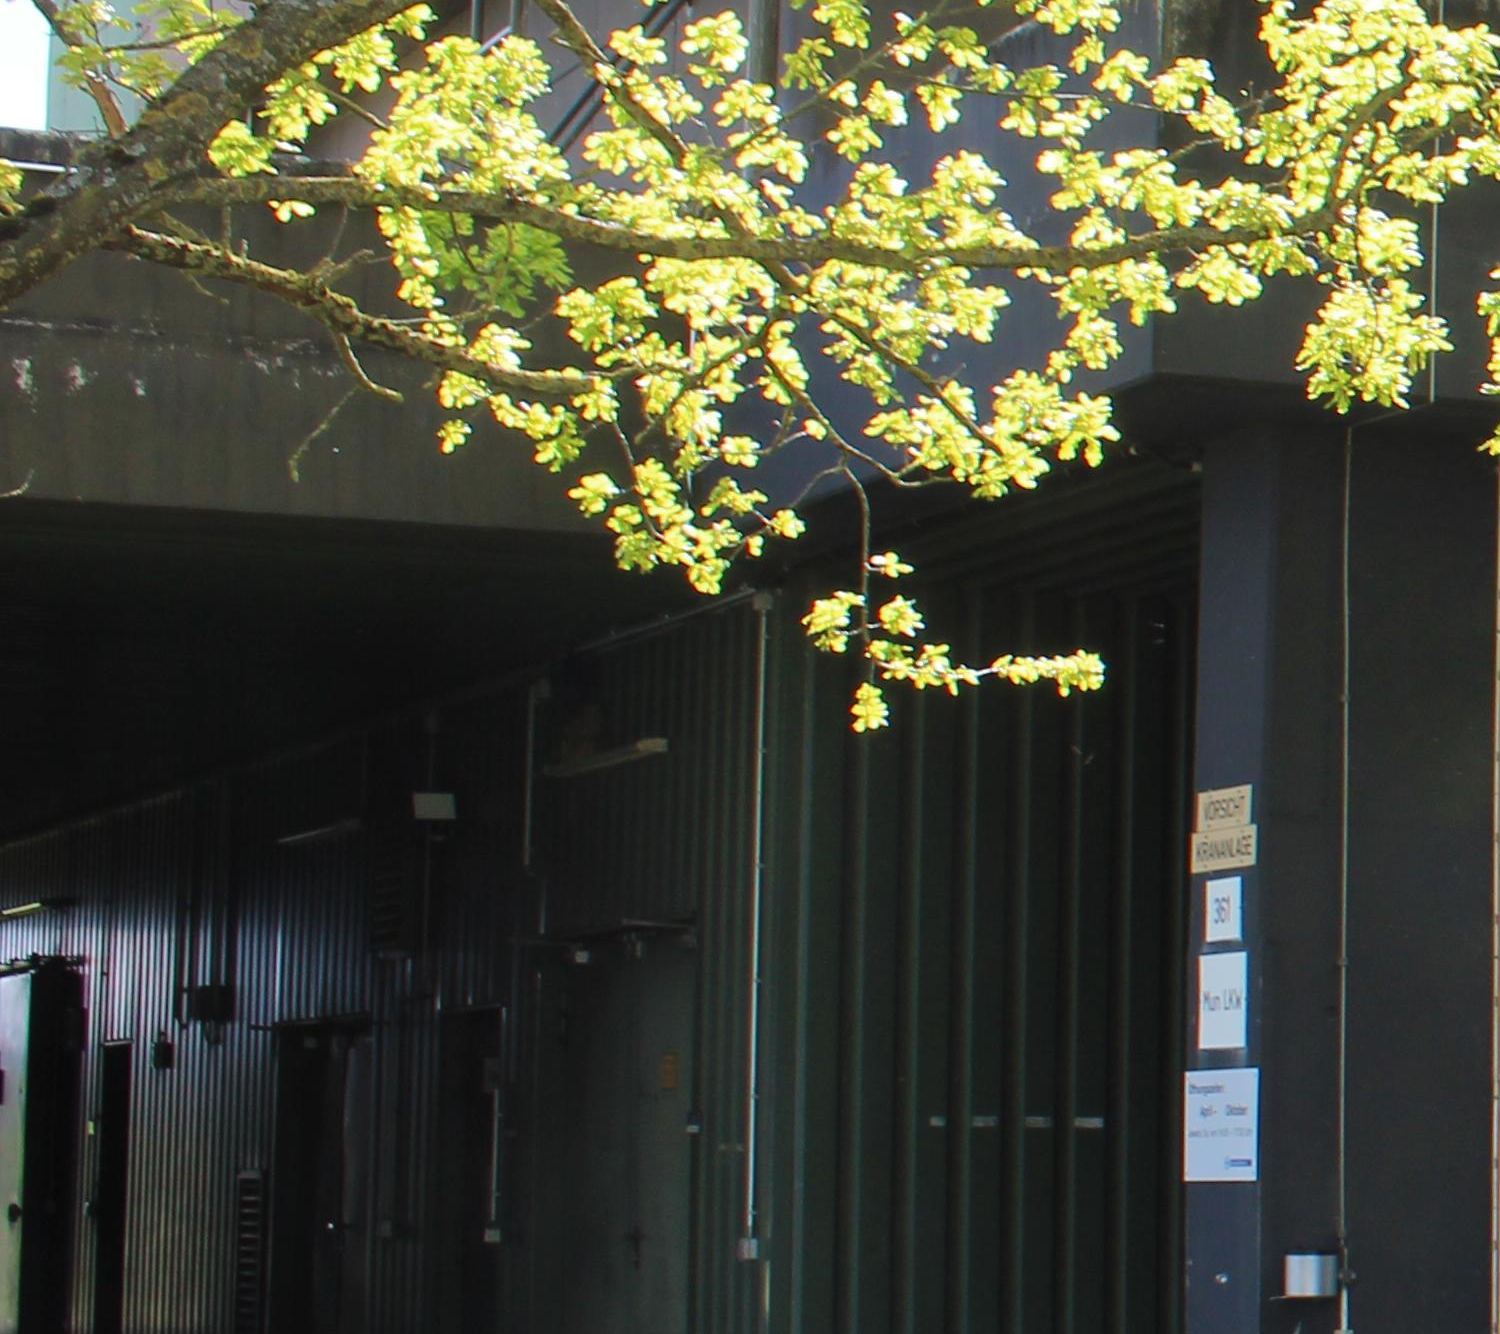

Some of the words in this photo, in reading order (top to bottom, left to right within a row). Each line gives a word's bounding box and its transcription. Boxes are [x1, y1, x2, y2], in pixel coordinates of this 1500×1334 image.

[1204, 795, 1246, 821] VORSICHT
[1197, 834, 1252, 862] KRANANLAGE
[1214, 895, 1231, 924] 361
